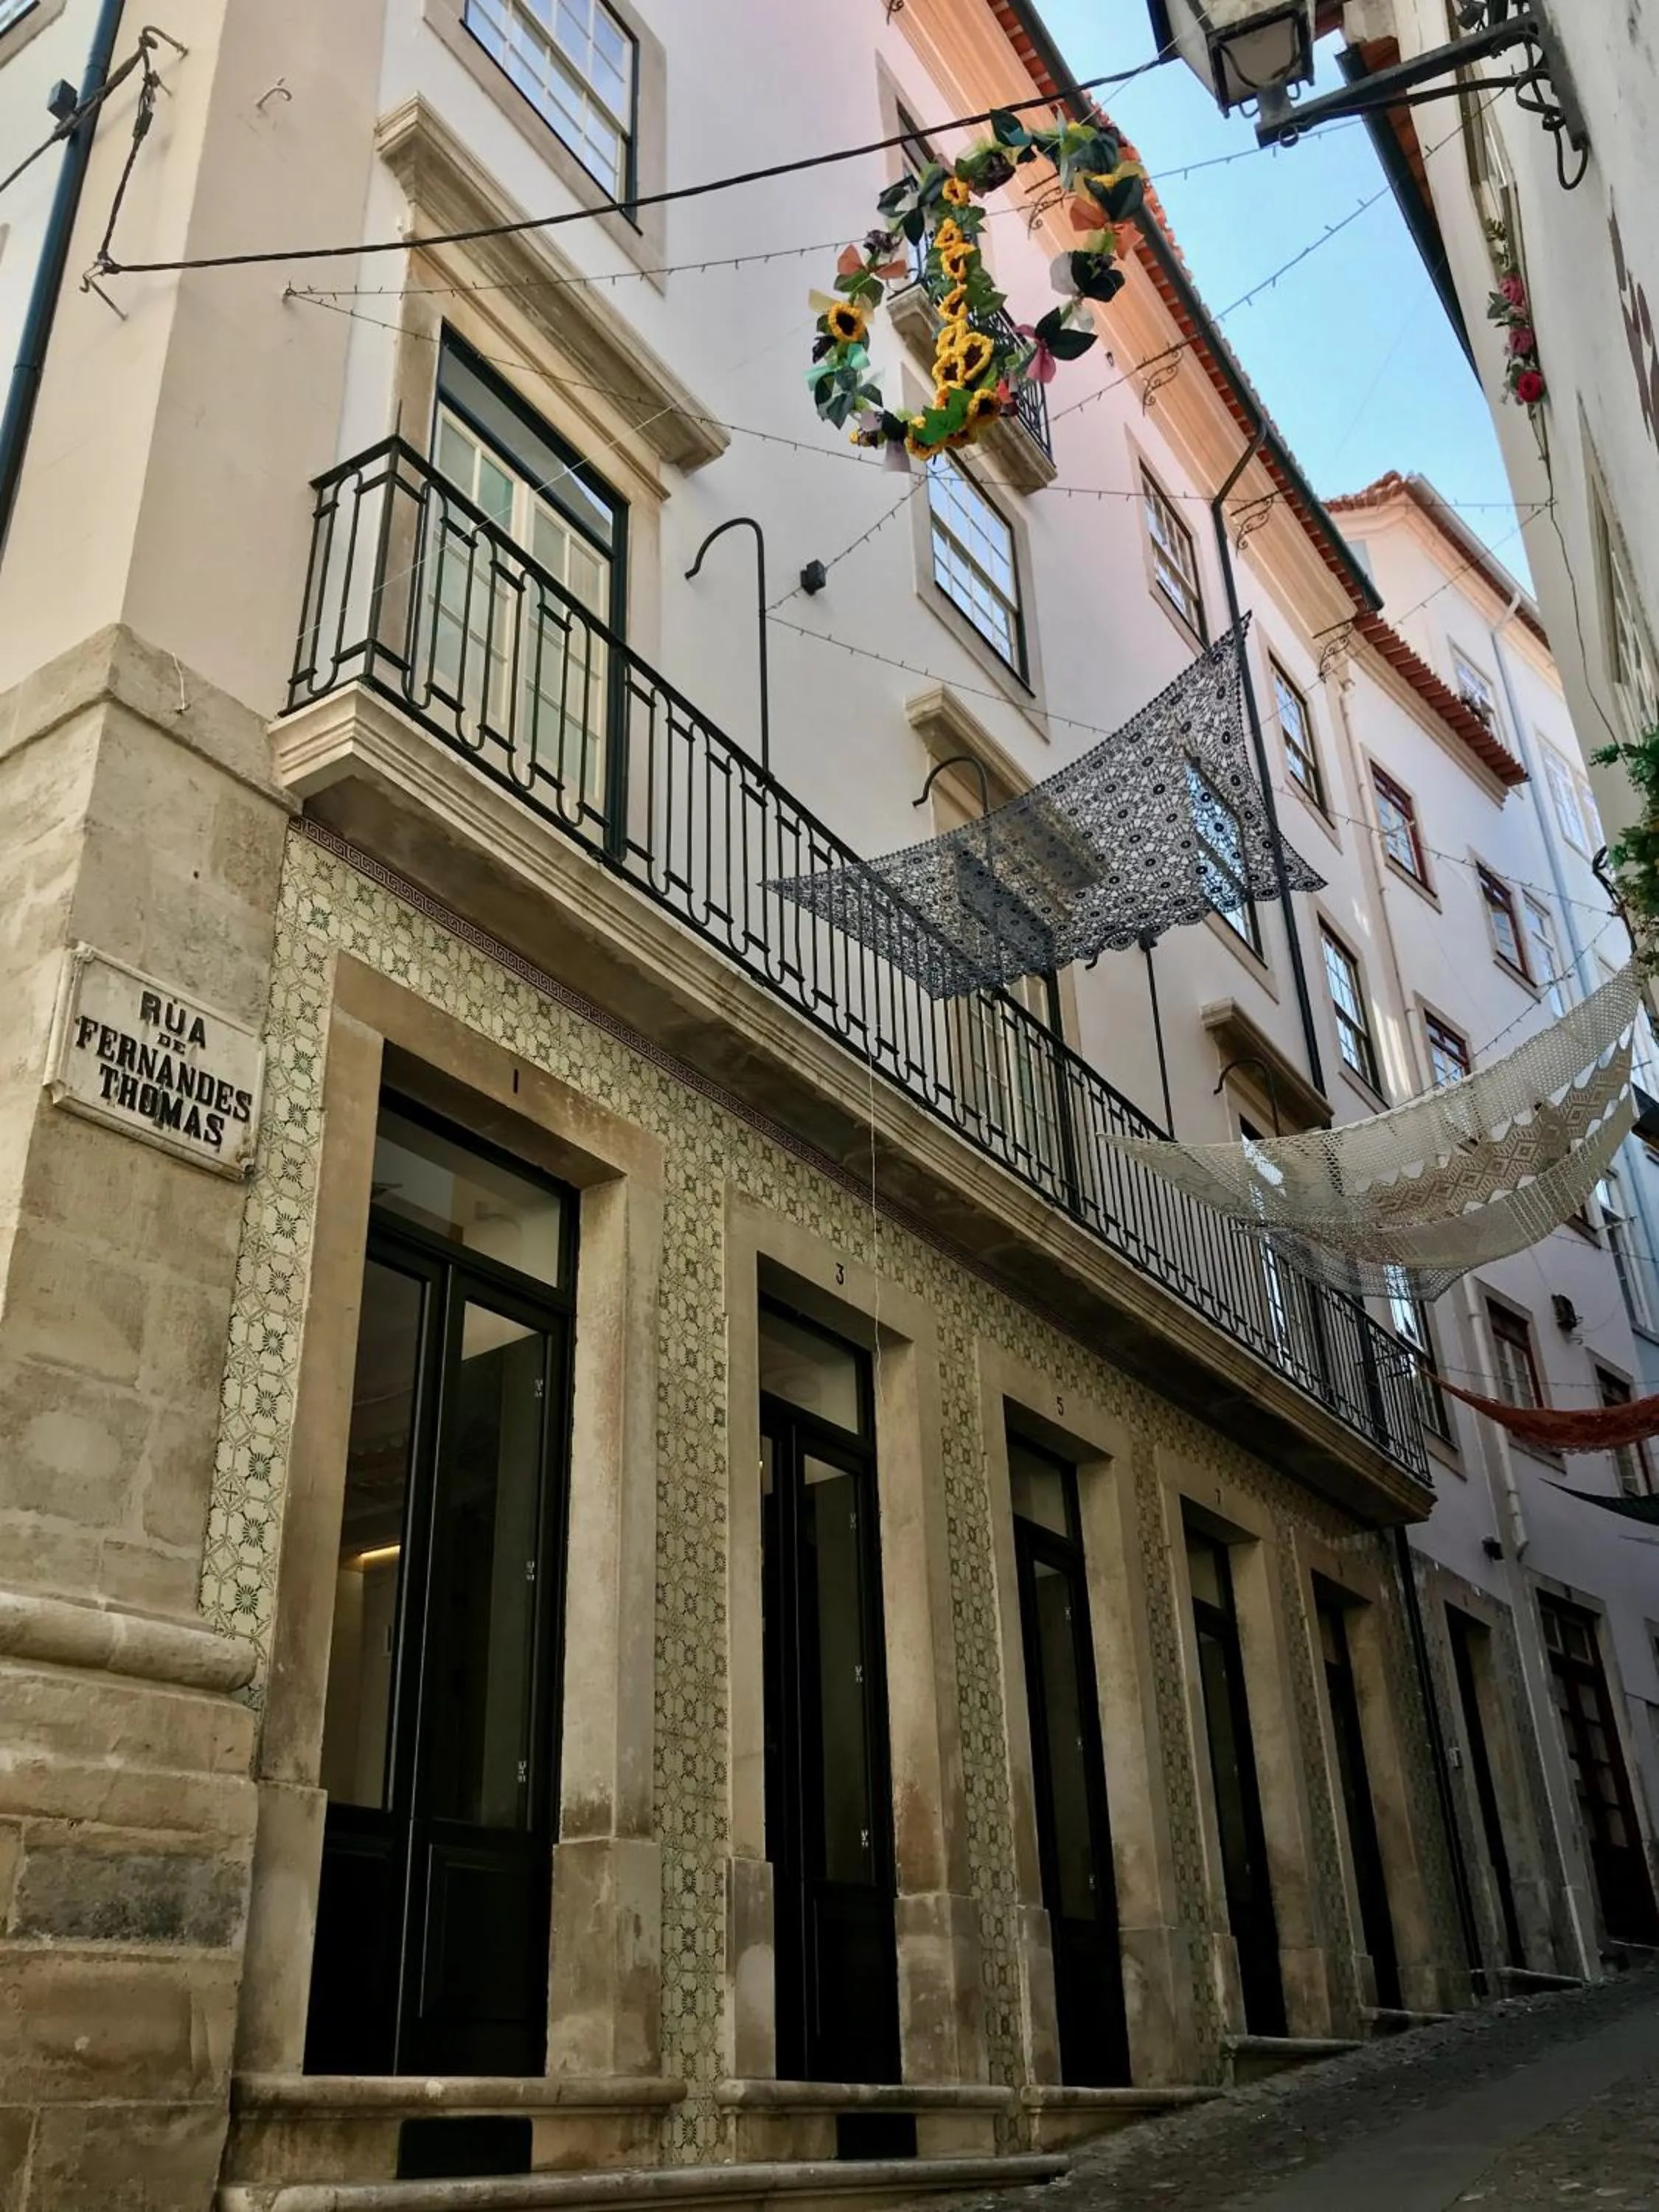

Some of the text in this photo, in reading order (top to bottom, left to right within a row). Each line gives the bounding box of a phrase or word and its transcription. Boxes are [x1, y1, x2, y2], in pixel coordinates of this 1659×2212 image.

[139, 991, 206, 1049] RUA
[157, 1032, 186, 1055] DE
[74, 1015, 253, 1123] FERNANDES
[512, 1068, 519, 1094] 1
[98, 1062, 225, 1146] THOMAS
[835, 1262, 845, 1285] 3
[1056, 1396, 1064, 1416] 5
